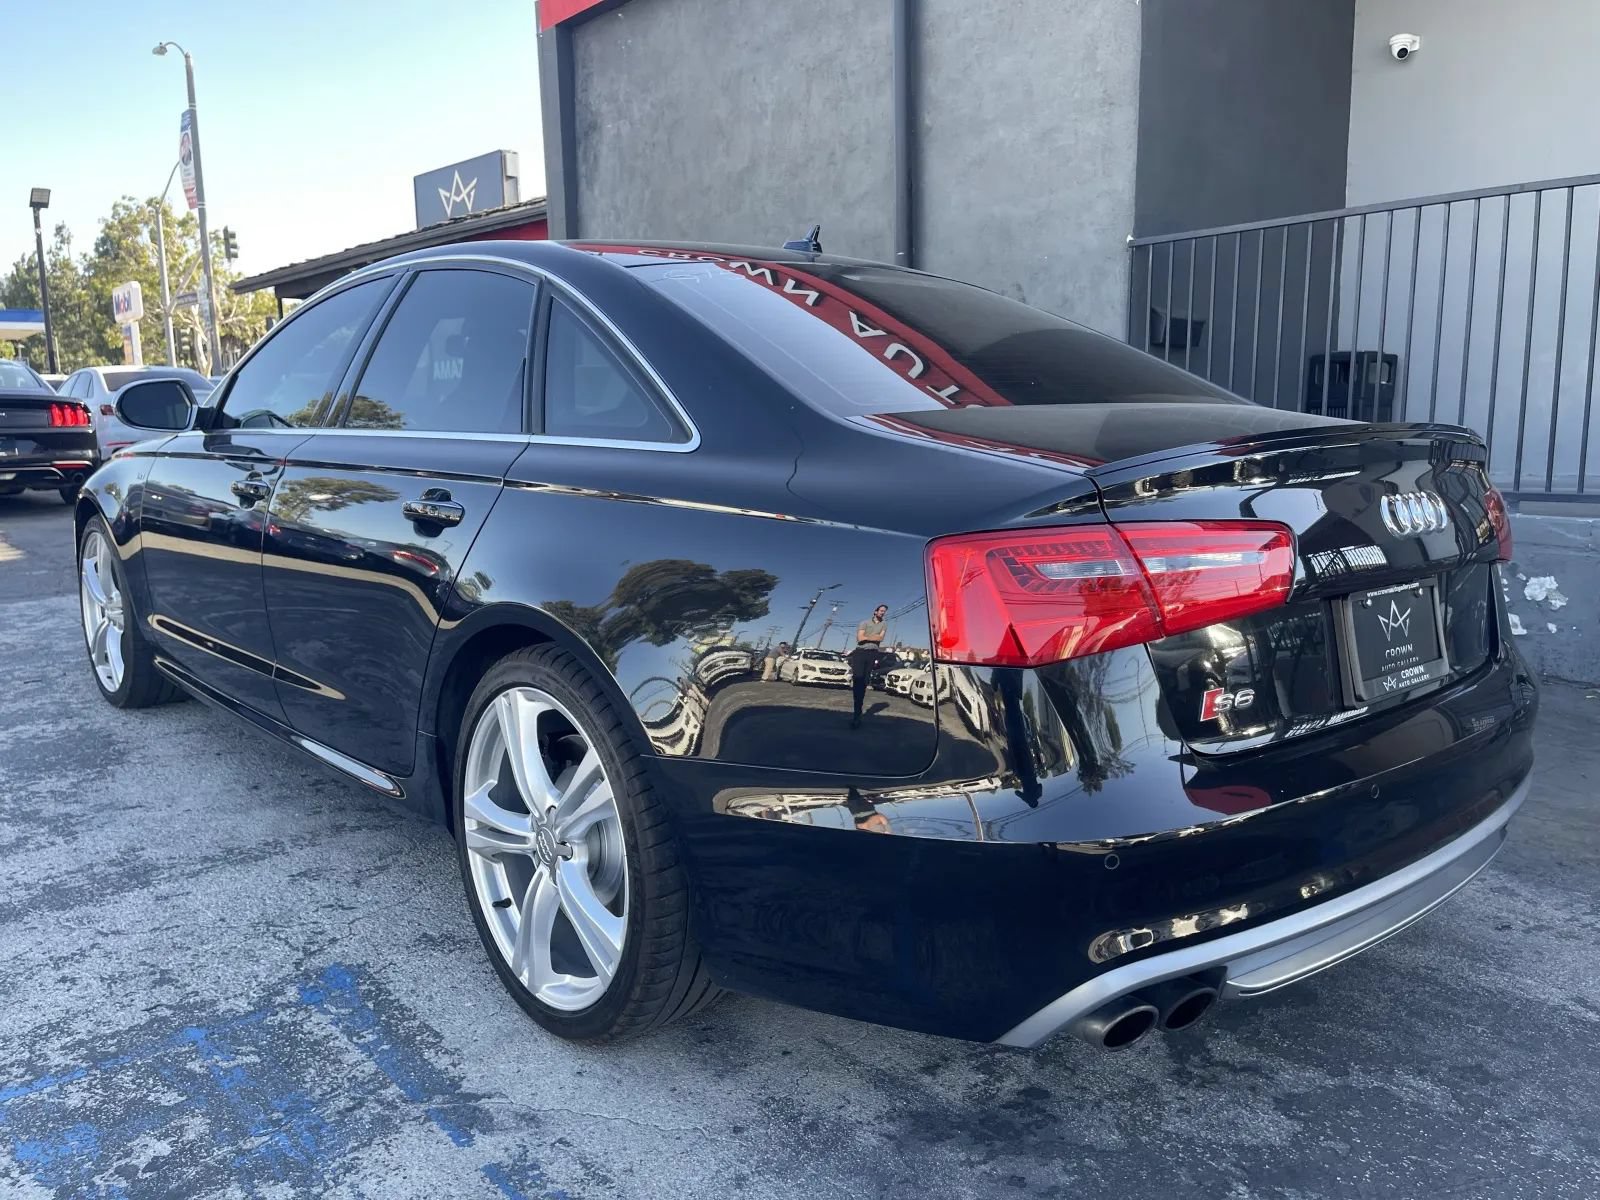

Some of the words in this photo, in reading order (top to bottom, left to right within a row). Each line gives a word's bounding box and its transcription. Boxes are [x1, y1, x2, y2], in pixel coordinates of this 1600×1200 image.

[114, 290, 132, 314] Mobil
[1401, 664, 1424, 679] CROWN
[1213, 689, 1255, 711] S6
